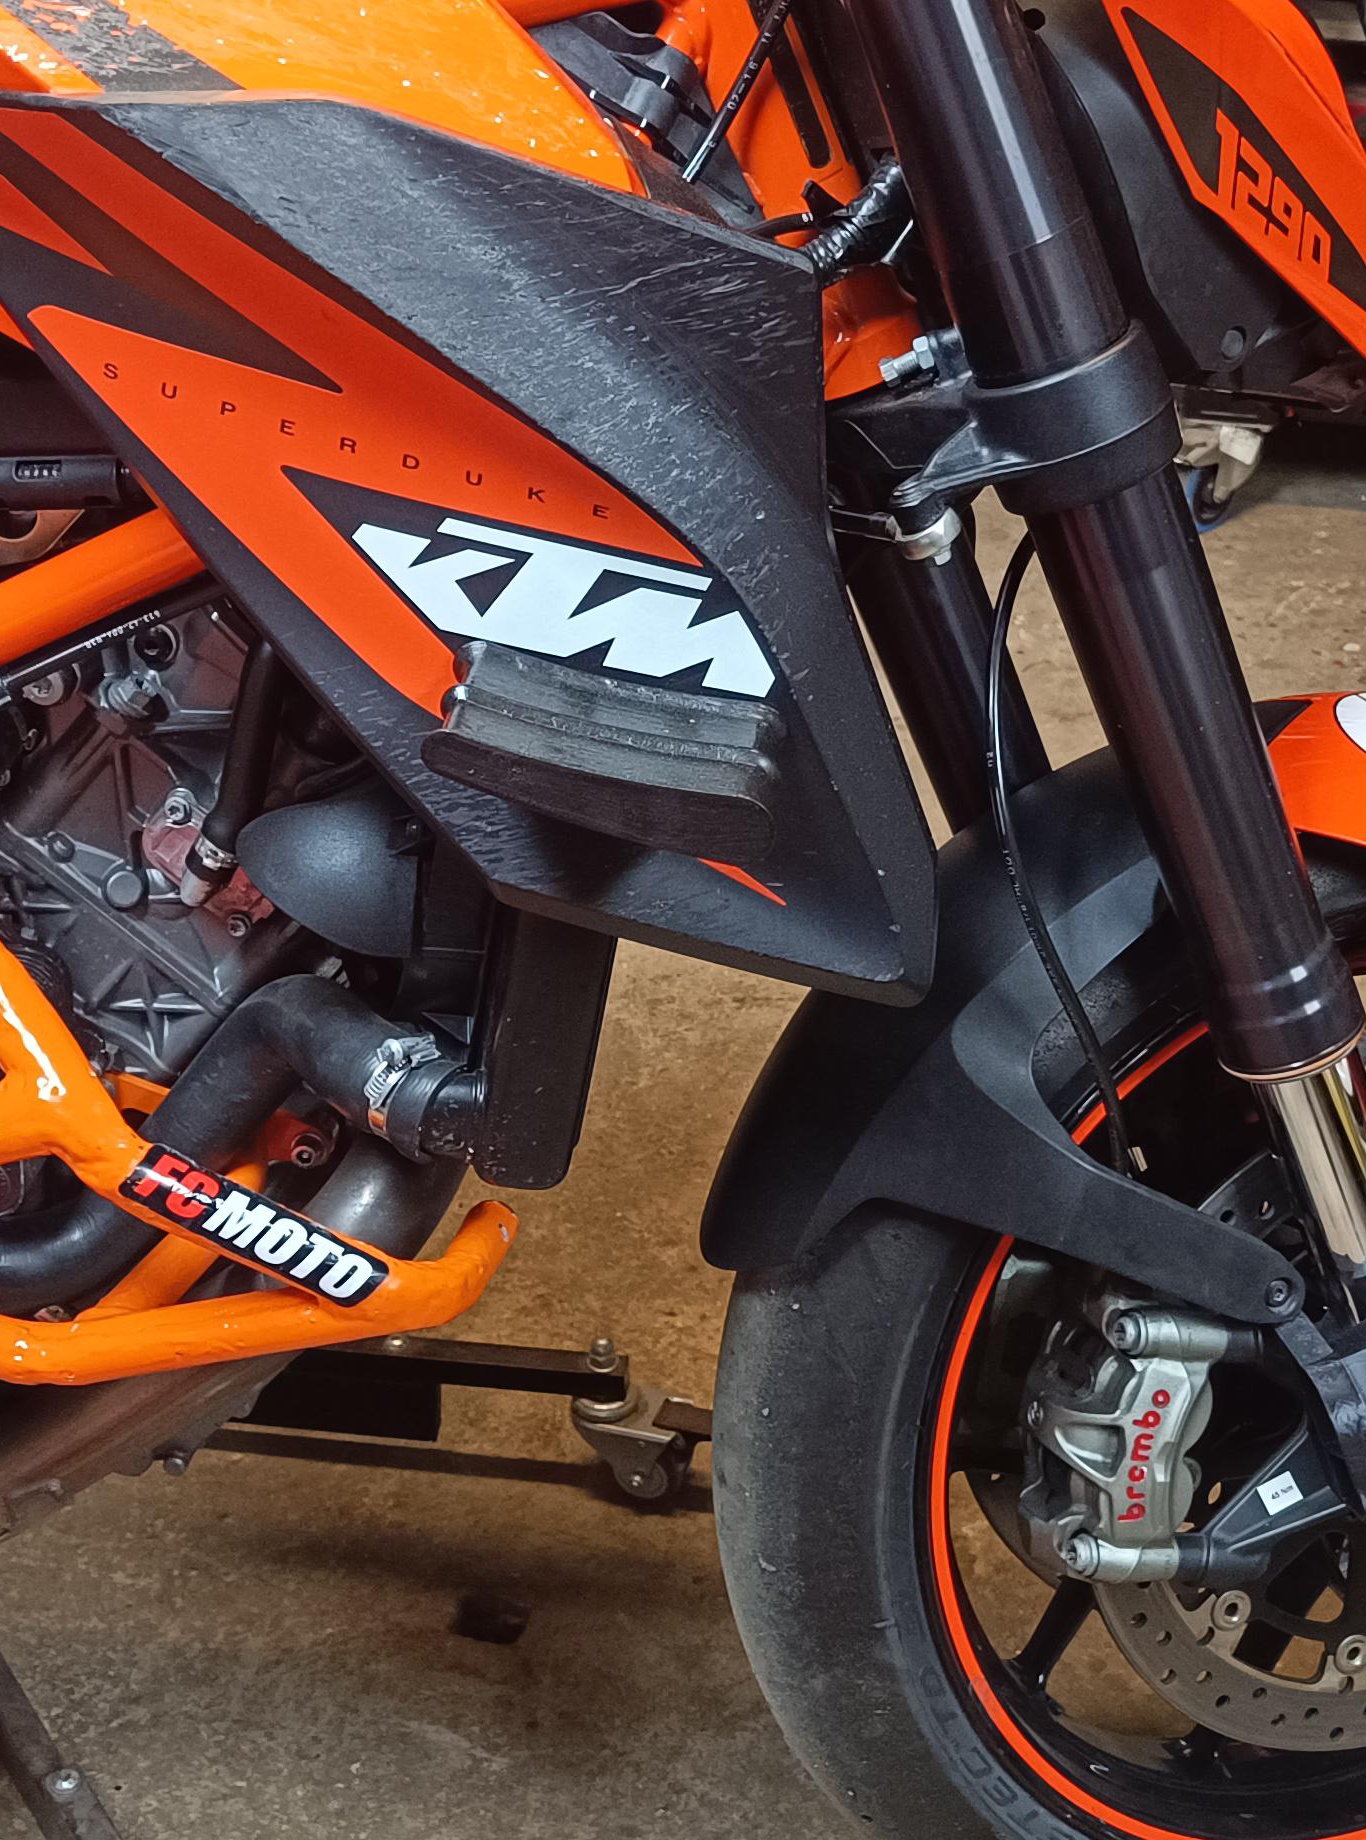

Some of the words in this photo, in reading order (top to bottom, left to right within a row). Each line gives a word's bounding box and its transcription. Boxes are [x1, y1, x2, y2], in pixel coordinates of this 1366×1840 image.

[1215, 107, 1331, 284] 1290
[352, 517, 777, 698] KTM
[1116, 1388, 1172, 1522] brembo
